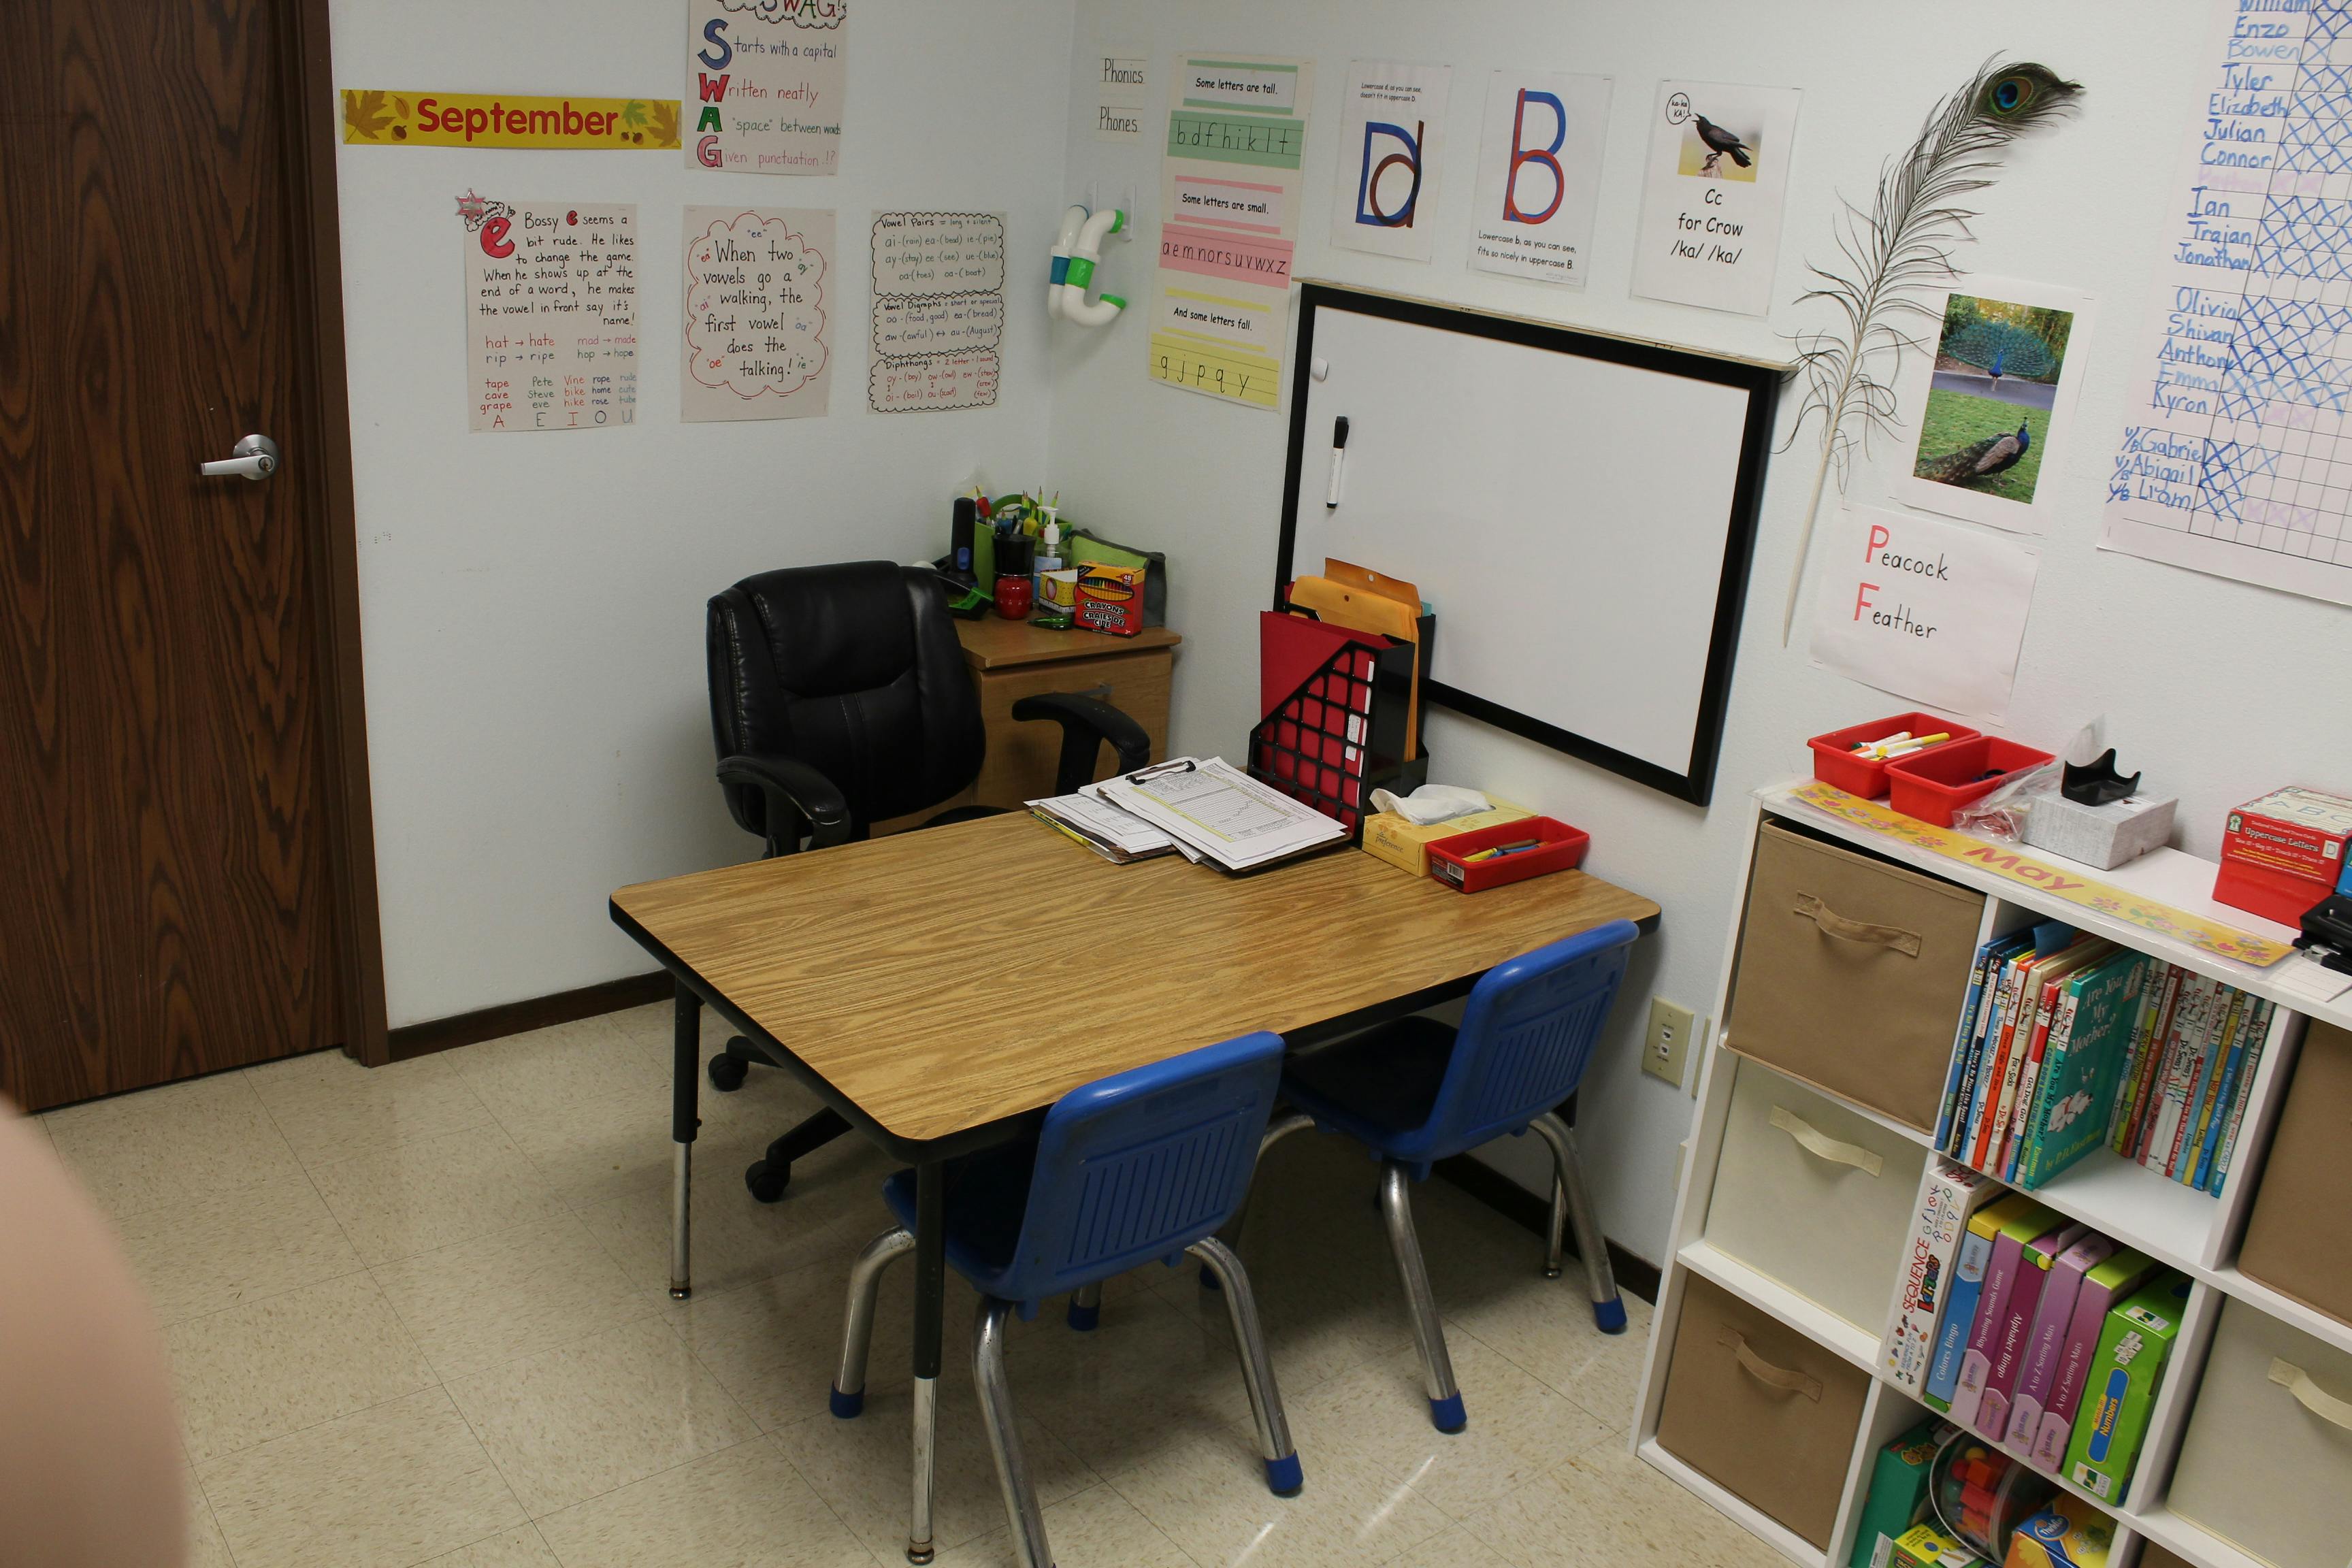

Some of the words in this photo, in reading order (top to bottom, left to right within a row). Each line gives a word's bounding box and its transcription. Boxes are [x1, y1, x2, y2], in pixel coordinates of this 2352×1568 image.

[2234, 16, 2289, 37] Enzo
[770, 40, 789, 56] with
[793, 47, 798, 56] a
[803, 43, 836, 61] capital
[2227, 39, 2302, 62] Bowen
[1104, 58, 1143, 84] Phonics
[2222, 63, 2273, 97] Tyler
[778, 82, 819, 108] neatly
[1195, 78, 1215, 89] Some
[1218, 78, 1243, 91] letters
[1247, 83, 1260, 93] are
[1262, 83, 1278, 95] tall.
[1673, 109, 1685, 118] KA!
[2208, 93, 2289, 117] Elizabeth
[416, 98, 619, 142] September
[697, 106, 723, 132] A
[781, 117, 821, 135] between
[1100, 106, 1138, 133] Phones
[2204, 118, 2266, 143] Julian
[758, 150, 818, 167] punctuation
[2201, 142, 2272, 168] Connor
[1182, 193, 1201, 205] Some
[1204, 195, 1230, 209] letters
[1232, 200, 1245, 210] are
[1247, 201, 1269, 214] small.
[1705, 189, 1723, 206] Cc
[2188, 186, 2230, 218] Ian
[525, 212, 559, 233] Bossy
[583, 216, 614, 225] seems
[621, 216, 627, 224] a
[881, 217, 906, 229] Vowel
[911, 218, 934, 227] Pairs
[1678, 213, 1701, 231] for
[1706, 217, 1744, 237] Crow
[527, 235, 544, 248] bit
[591, 232, 605, 245] He
[612, 233, 634, 246] likes
[1478, 229, 1514, 244] Lowercase
[1515, 235, 1522, 246] b,
[1534, 241, 1546, 249] you
[1563, 246, 1577, 254] see,
[2187, 220, 2252, 252] Trajan
[516, 254, 527, 264] to
[535, 251, 570, 269] change
[580, 250, 598, 262] the
[606, 254, 634, 268] game.
[715, 239, 755, 263] When
[768, 240, 794, 261] two
[1477, 246, 1490, 256] fits
[1501, 252, 1519, 263] nicely
[1529, 258, 1565, 269] uppercase
[1671, 240, 1705, 259] /ka/
[1708, 245, 1742, 265] /ka/
[2174, 242, 2251, 271] Jonathan
[484, 269, 511, 282] When
[515, 269, 527, 280] he
[534, 267, 568, 279] shows
[576, 270, 589, 281] up
[596, 265, 608, 277] at
[617, 265, 634, 278] the
[703, 267, 745, 284] vowels
[757, 274, 772, 291] go
[783, 272, 791, 282] a
[480, 287, 501, 297] end
[509, 283, 521, 295] of
[587, 282, 602, 294] he
[609, 283, 635, 295] makes
[720, 290, 772, 312] walking,
[780, 287, 803, 304] the
[479, 304, 498, 316] the
[502, 301, 534, 314] vowel
[540, 303, 550, 312] in
[553, 299, 580, 312] front
[586, 303, 604, 316] say
[613, 300, 628, 312] it's
[884, 302, 904, 310] Vowel
[908, 301, 941, 313] Digraphs
[2177, 287, 2238, 320] Olivia
[603, 312, 635, 326] name!
[705, 313, 736, 332] first
[749, 312, 784, 331] vowel
[1173, 307, 1188, 318] And
[1190, 310, 1208, 322] some
[1210, 313, 1235, 327] letters
[1238, 318, 1252, 331] fall.
[485, 336, 509, 348] hat
[529, 333, 555, 346] hate
[727, 338, 753, 354] does
[765, 336, 787, 353] the
[485, 353, 507, 368] rip
[530, 352, 555, 365] ripe
[577, 348, 595, 362] hop
[614, 348, 634, 360] hope
[886, 360, 933, 371] Diphthongs
[2157, 337, 2234, 376] Anthony
[2159, 360, 2220, 392] Emma
[2153, 380, 2209, 419] Kyron
[2139, 478, 2193, 512] Liam
[1865, 525, 1948, 581] Peacock
[1083, 612, 1112, 621] CRAIES
[1113, 616, 1125, 626] DE
[1084, 601, 1124, 615] CRAYONS
[1853, 583, 1937, 638] Feather
[2245, 827, 2287, 844] Uppercase
[2288, 838, 2319, 852] Letters
[1963, 846, 2085, 892] May
[2082, 989, 2102, 1010] Are
[2104, 975, 2124, 996] You
[1903, 1237, 1929, 1313] SEQUENCE
[1976, 1320, 1989, 1349] Rhyming
[1984, 1289, 1998, 1318] Sounds
[1993, 1269, 2004, 1291] Game
[2007, 1312, 2023, 1352] Alphabet
[2044, 1324, 2055, 1343] Mats
[1936, 1352, 1951, 1381] Colores
[1946, 1323, 1958, 1349] Bingo
[2036, 1342, 2048, 1369] Sorting
[2072, 1342, 2082, 1362] Mats
[1997, 1351, 2012, 1378] Bingo
[2034, 1367, 2040, 1375] Z
[2064, 1360, 2076, 1388] Sorting
[2032, 1375, 2040, 1384] to
[2062, 1384, 2068, 1393] Z
[2059, 1392, 2066, 1403] to
[2100, 1397, 2119, 1437] Numbers
